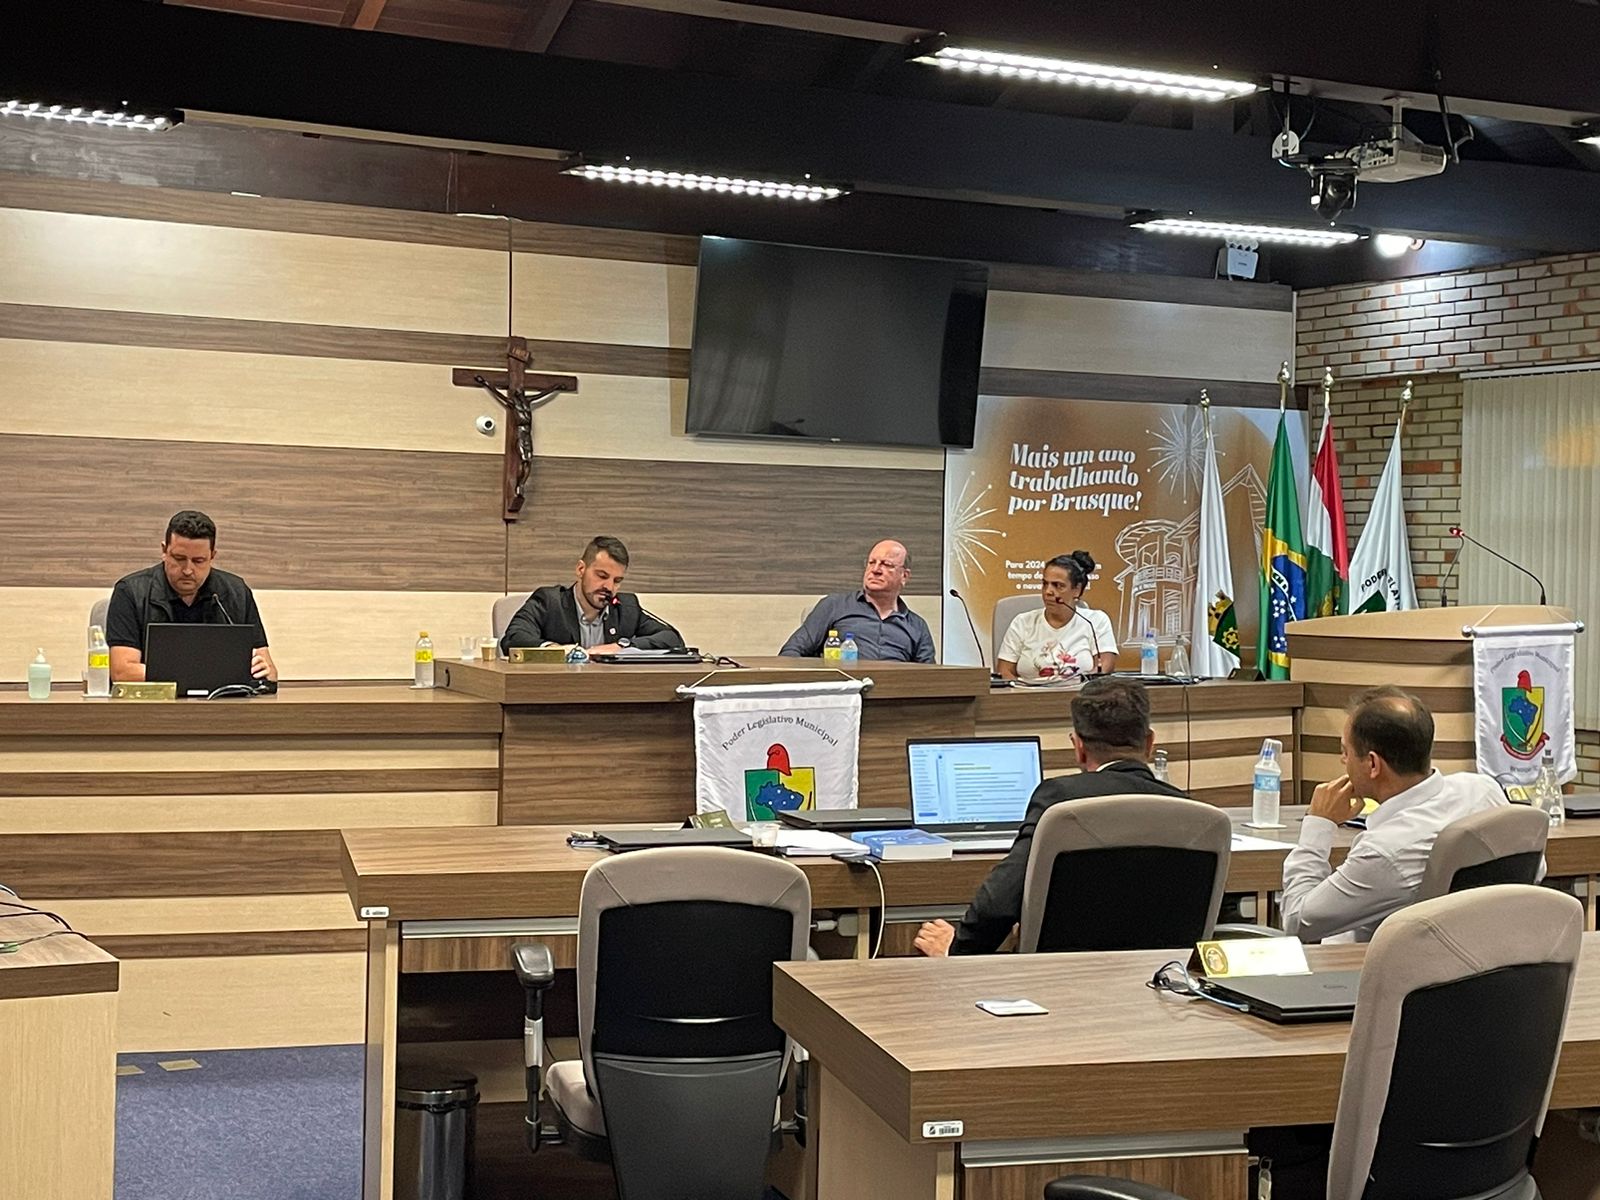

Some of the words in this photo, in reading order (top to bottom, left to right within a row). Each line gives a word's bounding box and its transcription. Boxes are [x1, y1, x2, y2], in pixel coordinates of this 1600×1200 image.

[1010, 443, 1060, 469] Mais
[1063, 450, 1095, 467] um
[1098, 449, 1136, 464] ano
[1009, 464, 1139, 492] trabalhando
[1008, 495, 1047, 515] por
[1049, 491, 1142, 517] Brusque!
[1005, 560, 1024, 569] Para
[1007, 571, 1032, 581] tempo
[722, 727, 746, 751] Poder
[747, 715, 794, 731] Legislativo
[795, 716, 839, 747] Municipal
